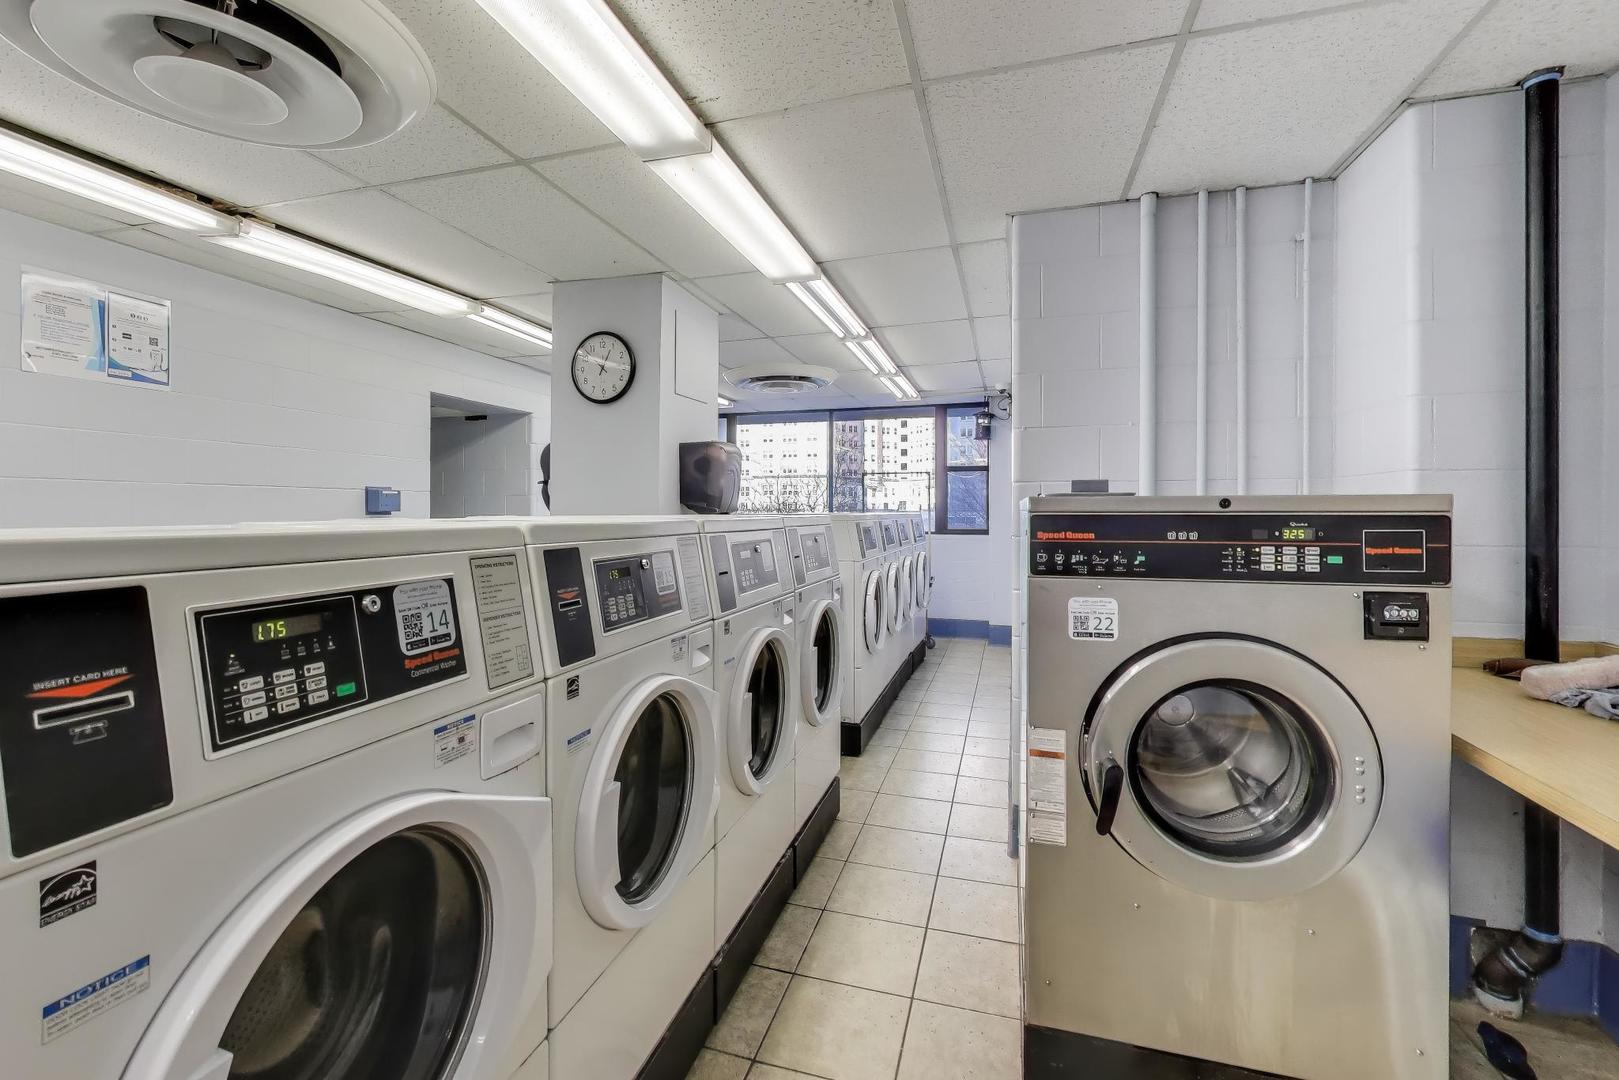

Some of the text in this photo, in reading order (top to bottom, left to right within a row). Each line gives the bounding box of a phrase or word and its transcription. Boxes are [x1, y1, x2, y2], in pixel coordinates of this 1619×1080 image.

[1037, 531, 1096, 541] Speed Queen
[426, 609, 450, 634] 14
[1093, 616, 1115, 631] 22
[33, 666, 129, 691] INSERT CARD HERE
